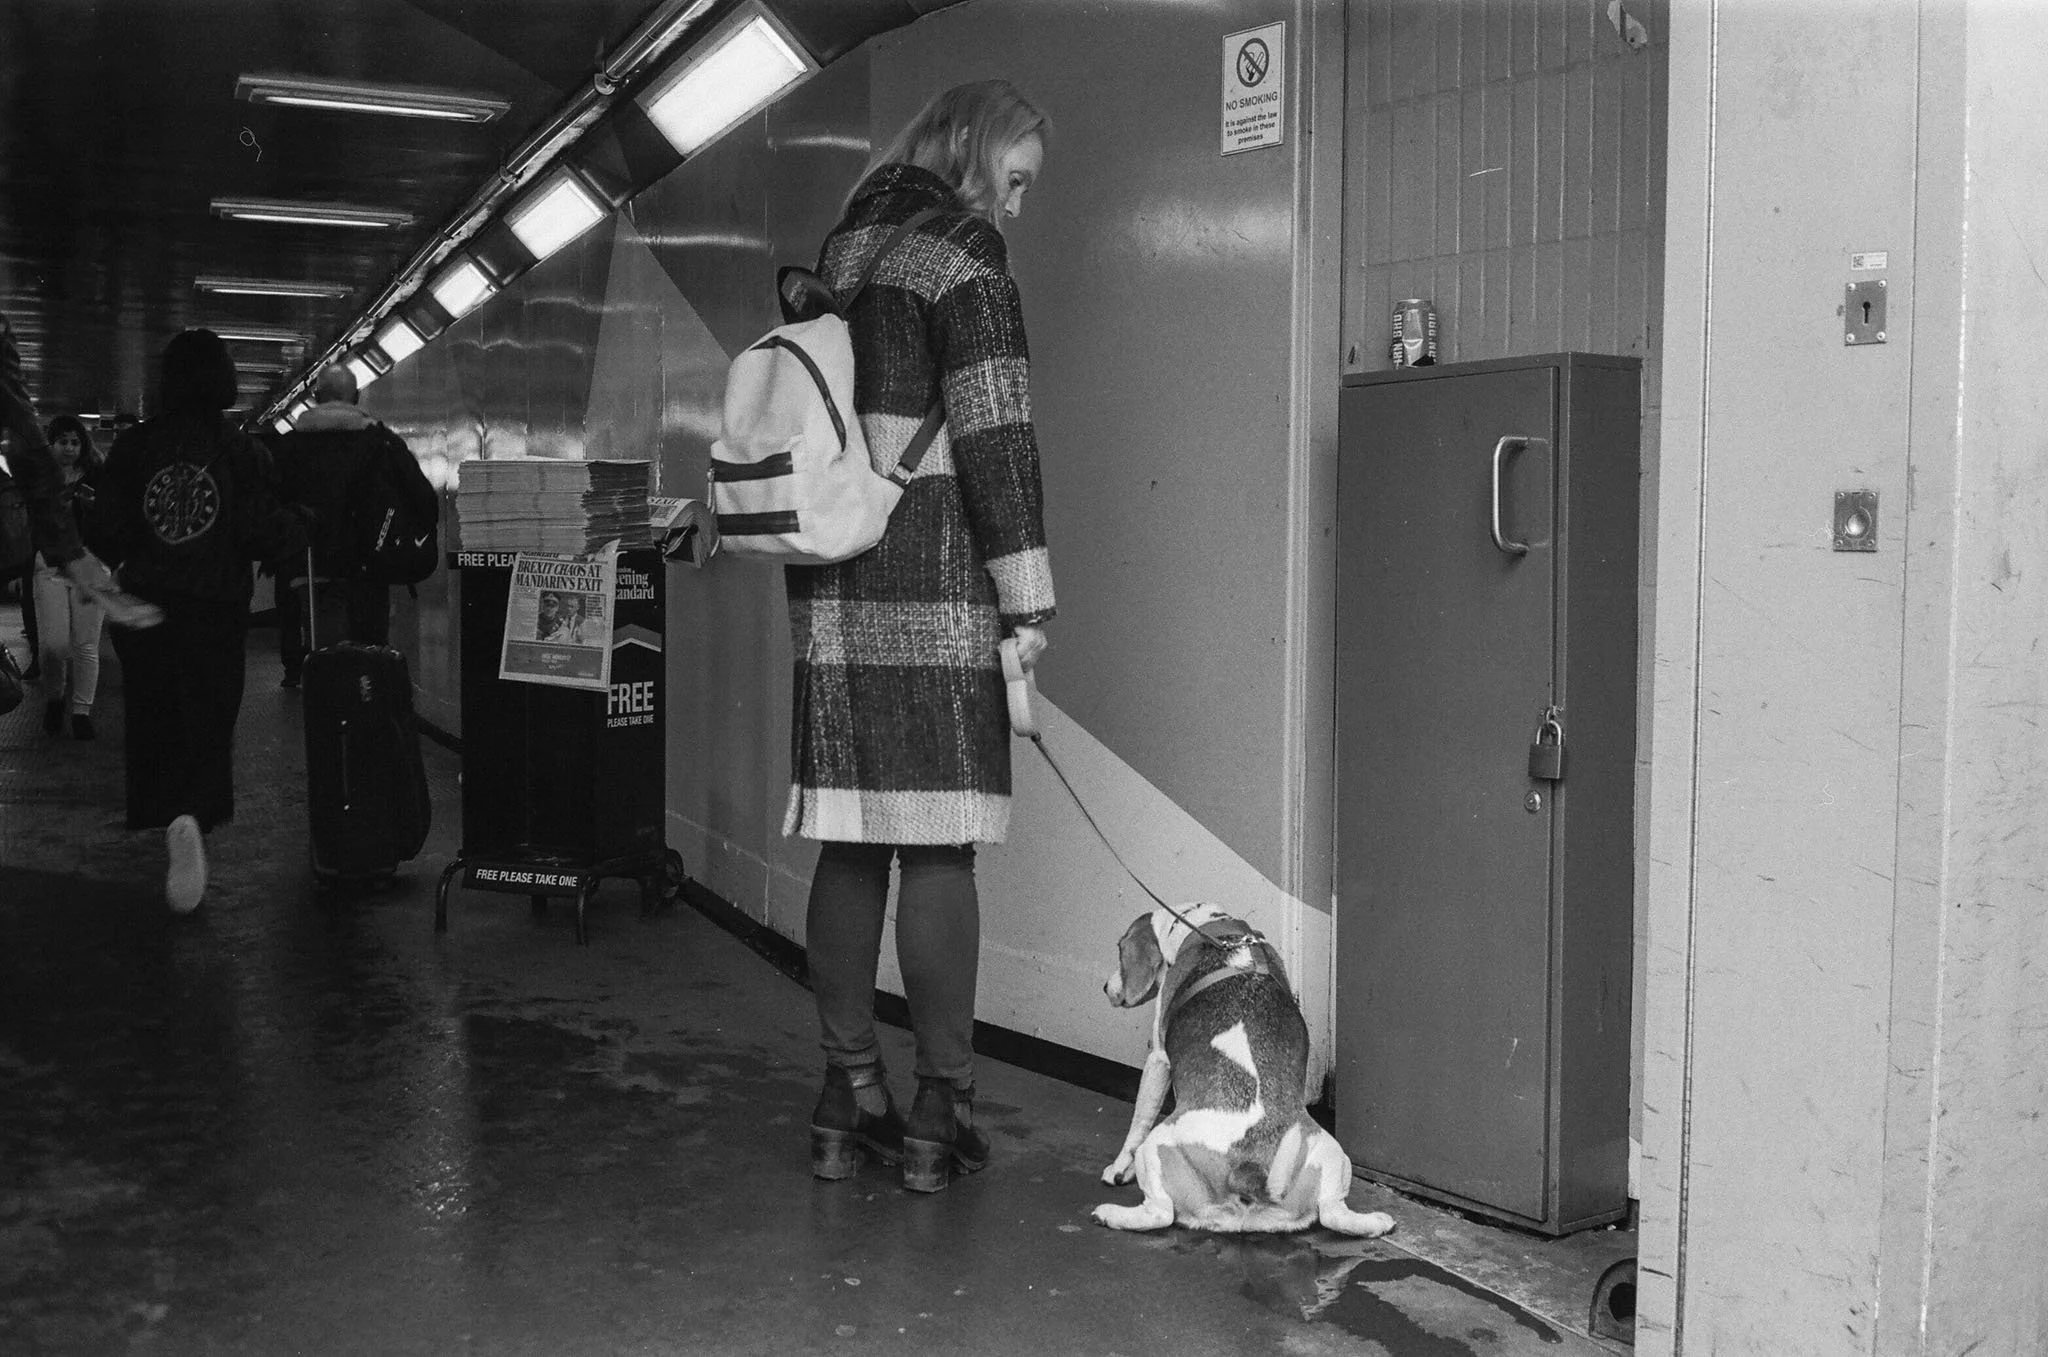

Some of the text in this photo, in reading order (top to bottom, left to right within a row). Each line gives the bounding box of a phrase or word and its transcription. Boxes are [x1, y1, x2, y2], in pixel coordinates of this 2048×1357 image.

[1225, 91, 1278, 111] NO SMOKING
[1225, 120, 1230, 128] It
[1230, 119, 1235, 127] is
[1236, 115, 1257, 126] against
[1257, 113, 1267, 121] the
[1227, 129, 1233, 137] to
[1234, 126, 1252, 136] smoke
[1259, 122, 1275, 130] these
[1238, 134, 1263, 145] premises
[457, 553, 515, 567] FREE PLEA
[516, 560, 602, 578] BREXIT CHAOS AT
[515, 573, 603, 591] MANDARIN'S EXIT
[615, 570, 649, 588] ening
[614, 584, 655, 600] andard
[607, 681, 654, 715] FREE
[607, 714, 654, 728] PLEASE TAKE ONE
[476, 868, 578, 887] FREE PLEASE TAKE ONE
